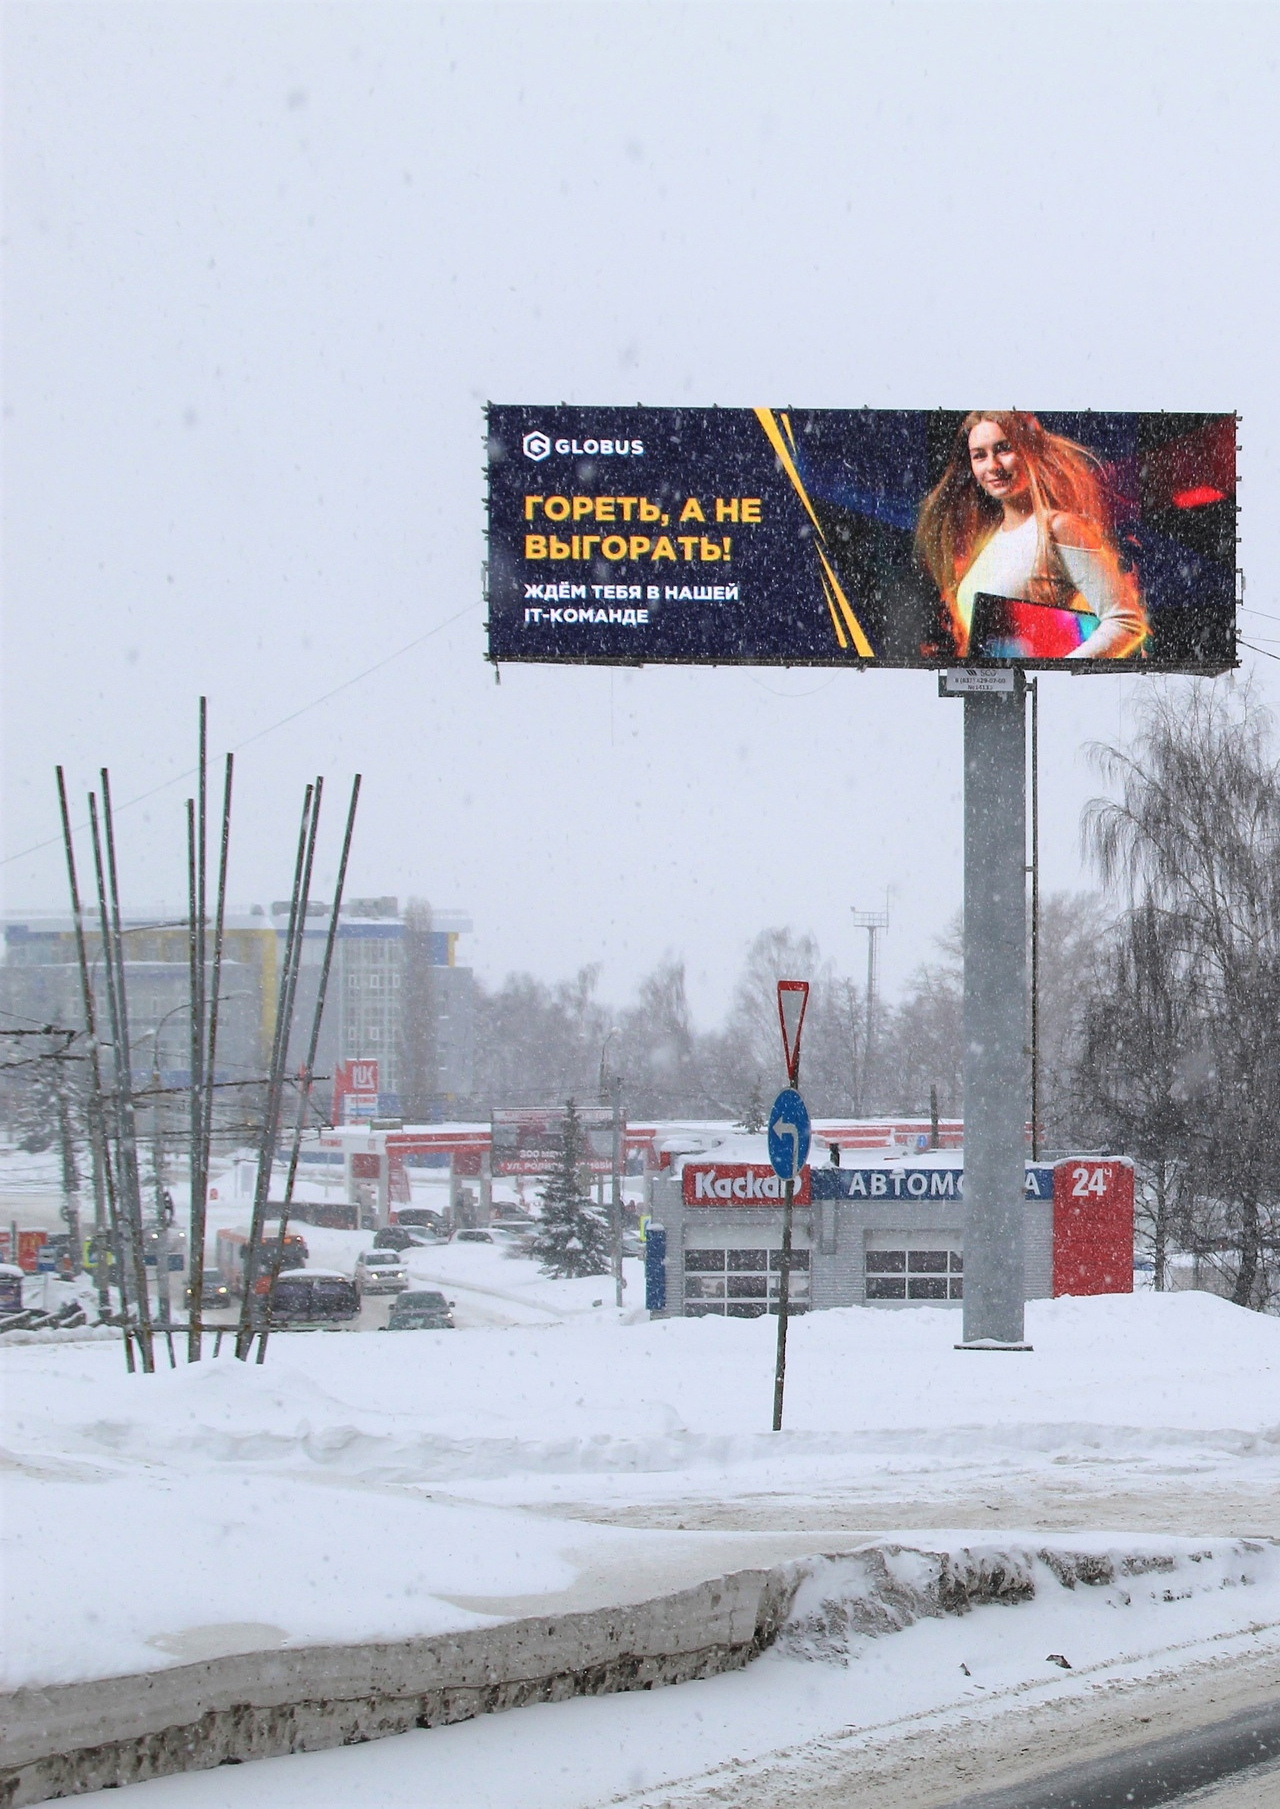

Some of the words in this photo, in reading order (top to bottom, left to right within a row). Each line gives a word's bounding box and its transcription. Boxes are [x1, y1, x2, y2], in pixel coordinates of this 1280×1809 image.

[555, 438, 645, 456] GLOBUS
[524, 495, 669, 527] ГОРЕТЬ,
[680, 498, 705, 522] А
[716, 498, 762, 523] НЕ
[525, 534, 732, 561] ВЫГОРАТЬ!
[524, 581, 586, 601] ЖДЁМ
[590, 584, 641, 600] ТЕБЯ
[647, 585, 660, 600] В
[664, 583, 739, 601] НАШЕЙ
[524, 608, 649, 626] IT-КОМАНДЕ
[849, 1171, 1041, 1196] АВТОМА
